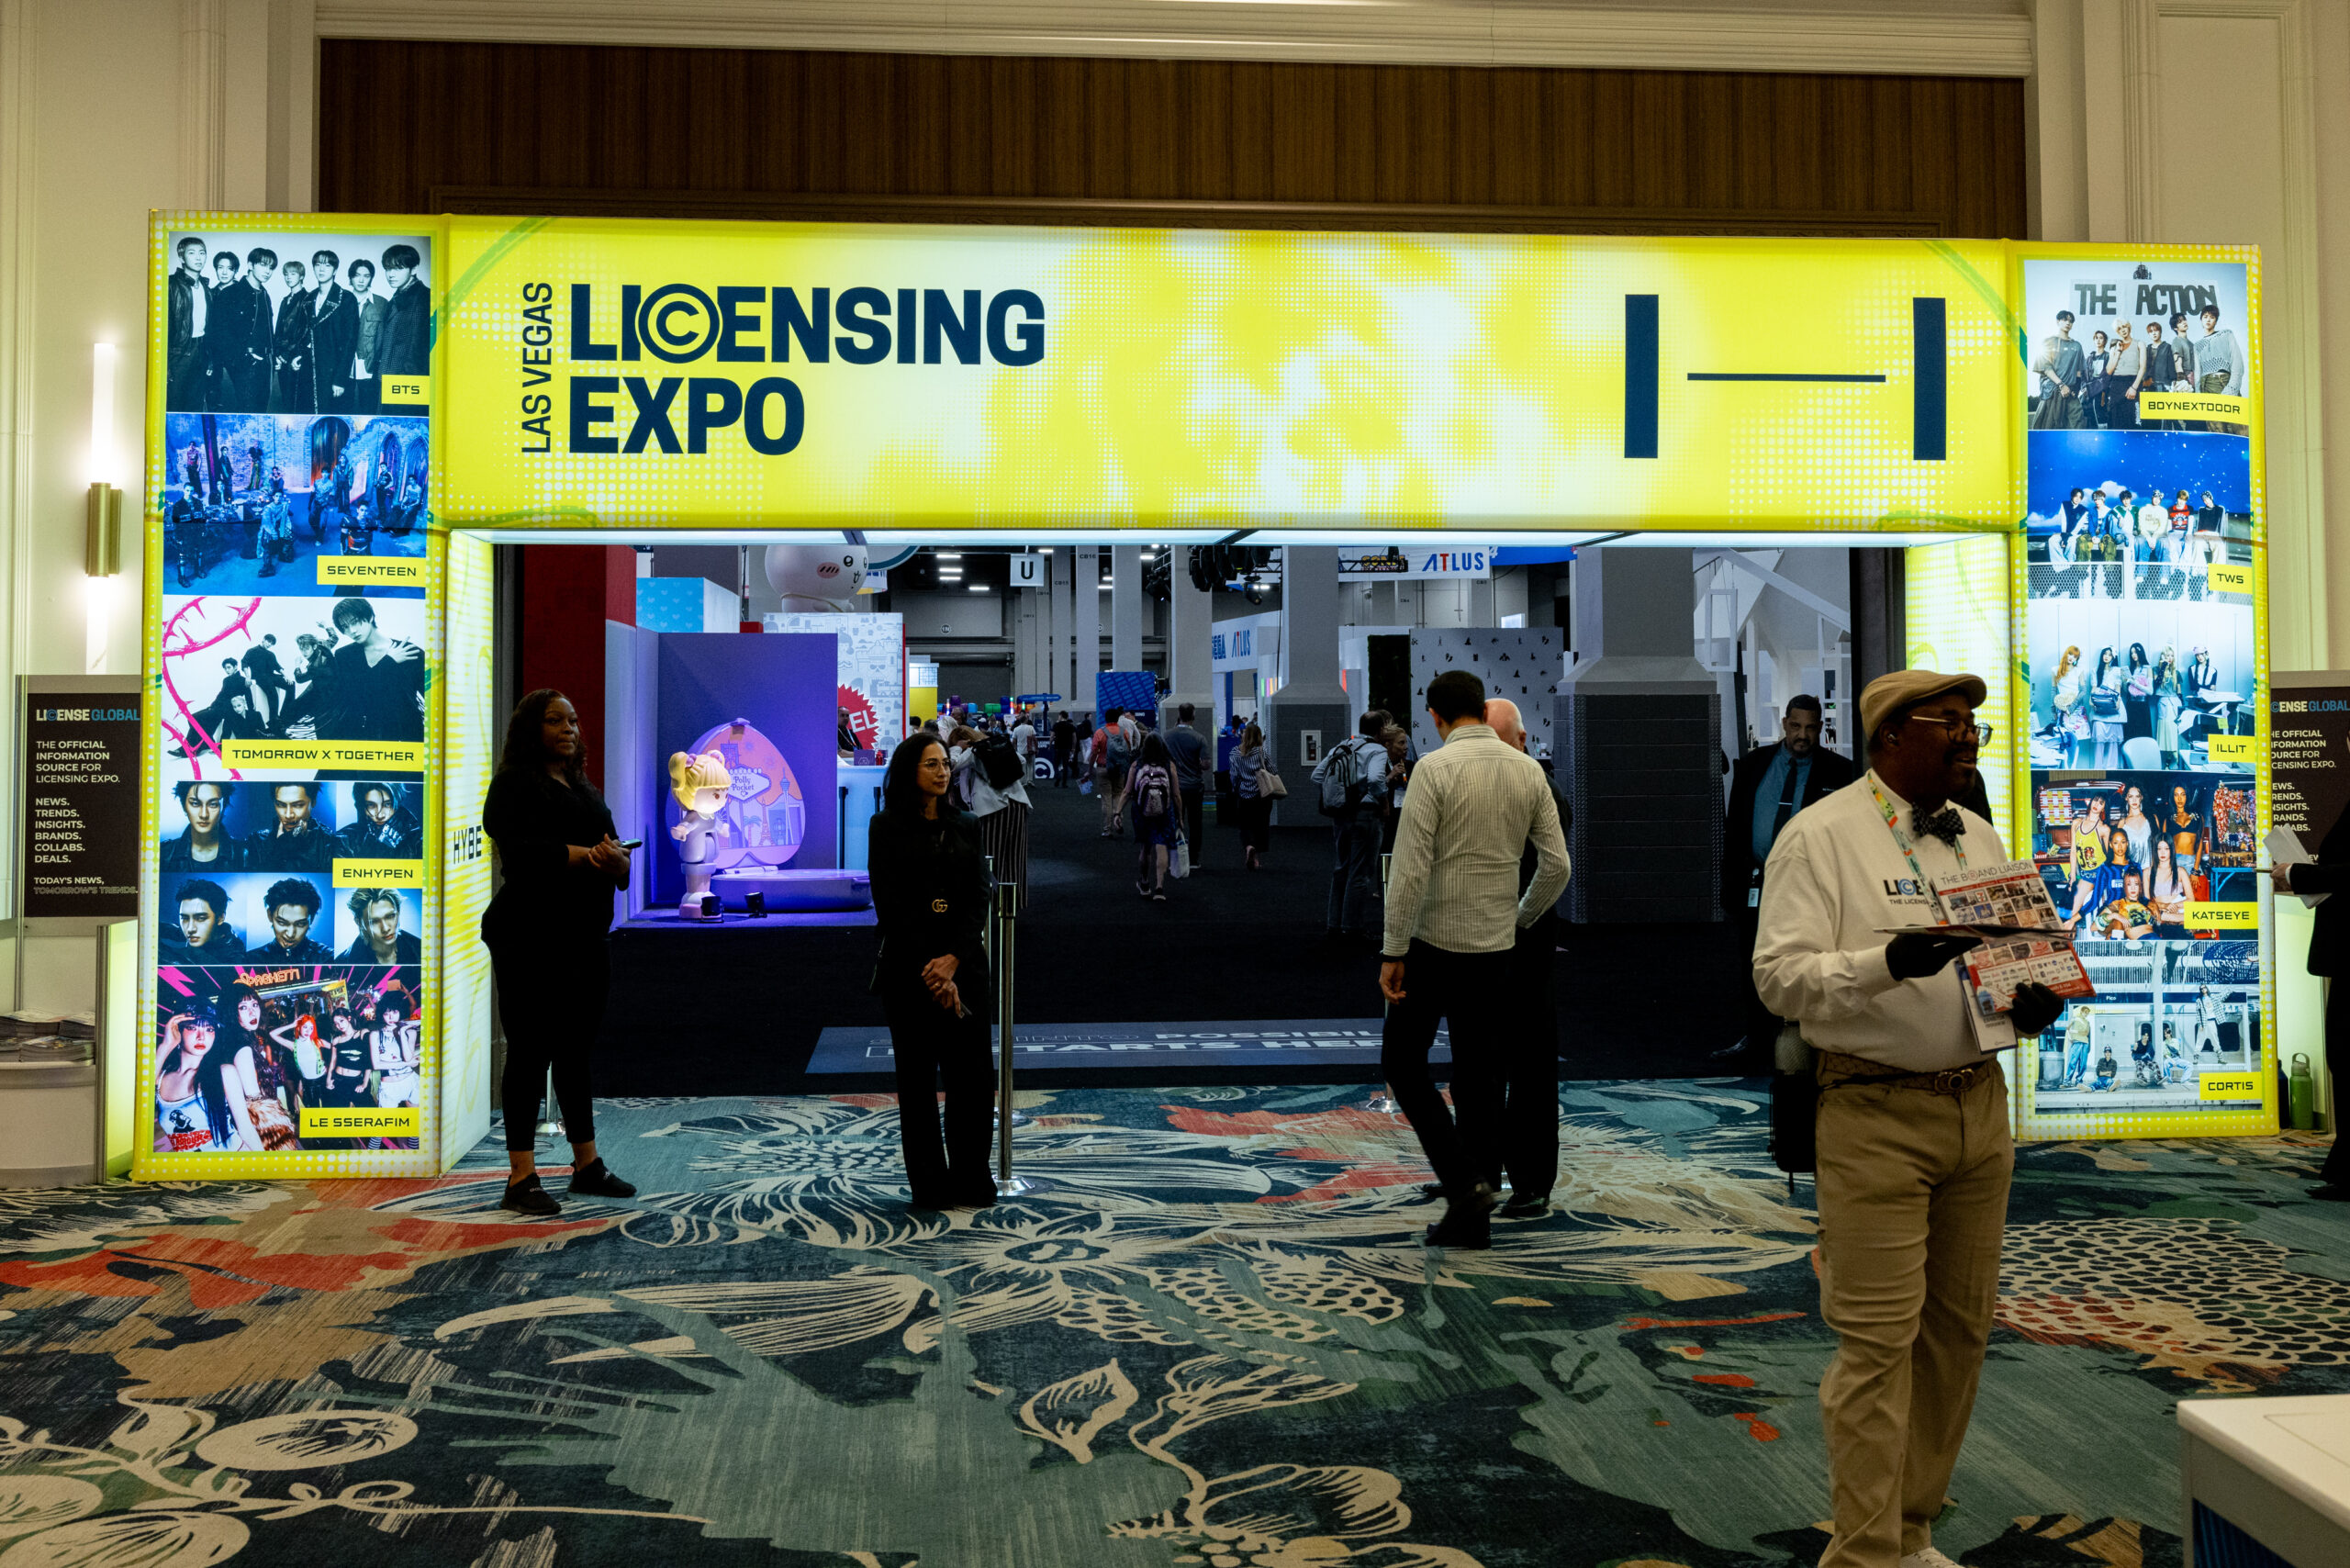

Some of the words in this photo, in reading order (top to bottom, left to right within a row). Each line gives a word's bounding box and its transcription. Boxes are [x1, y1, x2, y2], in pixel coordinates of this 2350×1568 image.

[2074, 284, 2117, 315] THE
[2135, 284, 2218, 315] ACTION
[521, 281, 553, 387] VEGAS
[392, 385, 420, 395] BTS
[2148, 401, 2241, 414] BOYNEXTDOOR
[569, 375, 804, 455] EXPO
[520, 393, 552, 453] LAS
[1422, 553, 1484, 572] ATLUS
[327, 566, 417, 577] SEVENTEEN
[1021, 561, 1034, 579] U
[2217, 573, 2244, 584] TWS
[1212, 633, 1226, 660] EGA
[1232, 630, 1250, 658] ATLUS
[91, 709, 140, 722] GLOBAL
[849, 710, 876, 733] EL
[2282, 730, 2322, 738] OFFICIAL
[37, 741, 56, 749] THE
[58, 741, 106, 749] OFFICIAL
[2217, 744, 2246, 753] ILLIT
[2271, 740, 2326, 748] FORMATION
[36, 752, 109, 760] INFORMATION
[232, 749, 318, 760] TOMORROW
[322, 750, 330, 759] X
[335, 750, 414, 761] TOGETHER
[2271, 751, 2300, 759] OURCE
[2302, 750, 2320, 758] FOR
[36, 764, 79, 772] SOURCE
[81, 763, 102, 771] FOR
[2271, 761, 2310, 769] CENSING
[2311, 760, 2337, 768] EXPO.
[36, 775, 88, 783] LICENSING
[91, 775, 120, 783] EXPO.
[733, 776, 752, 784] Polly
[732, 783, 755, 791] Pocket
[36, 798, 70, 806] NEWS.
[2274, 813, 2307, 822] RANDS.
[35, 821, 85, 829] INSIGHTS.
[35, 832, 82, 840] BRANDS.
[35, 844, 85, 852] COLLABS.
[453, 824, 482, 865] HYBE
[34, 855, 72, 863] DEALS.
[342, 868, 414, 879] ENHYPEN
[1941, 874, 1958, 885] THE
[1998, 861, 2033, 874] LIAISON
[34, 877, 73, 885] TODAY'S
[74, 877, 105, 885] NEWS,
[2192, 911, 2250, 920] KATSEYE
[991, 1042, 1241, 1052] TARTS
[2208, 1081, 2253, 1091] CORTIS
[310, 1117, 328, 1127] LE
[333, 1117, 409, 1127] SSERAFIM
